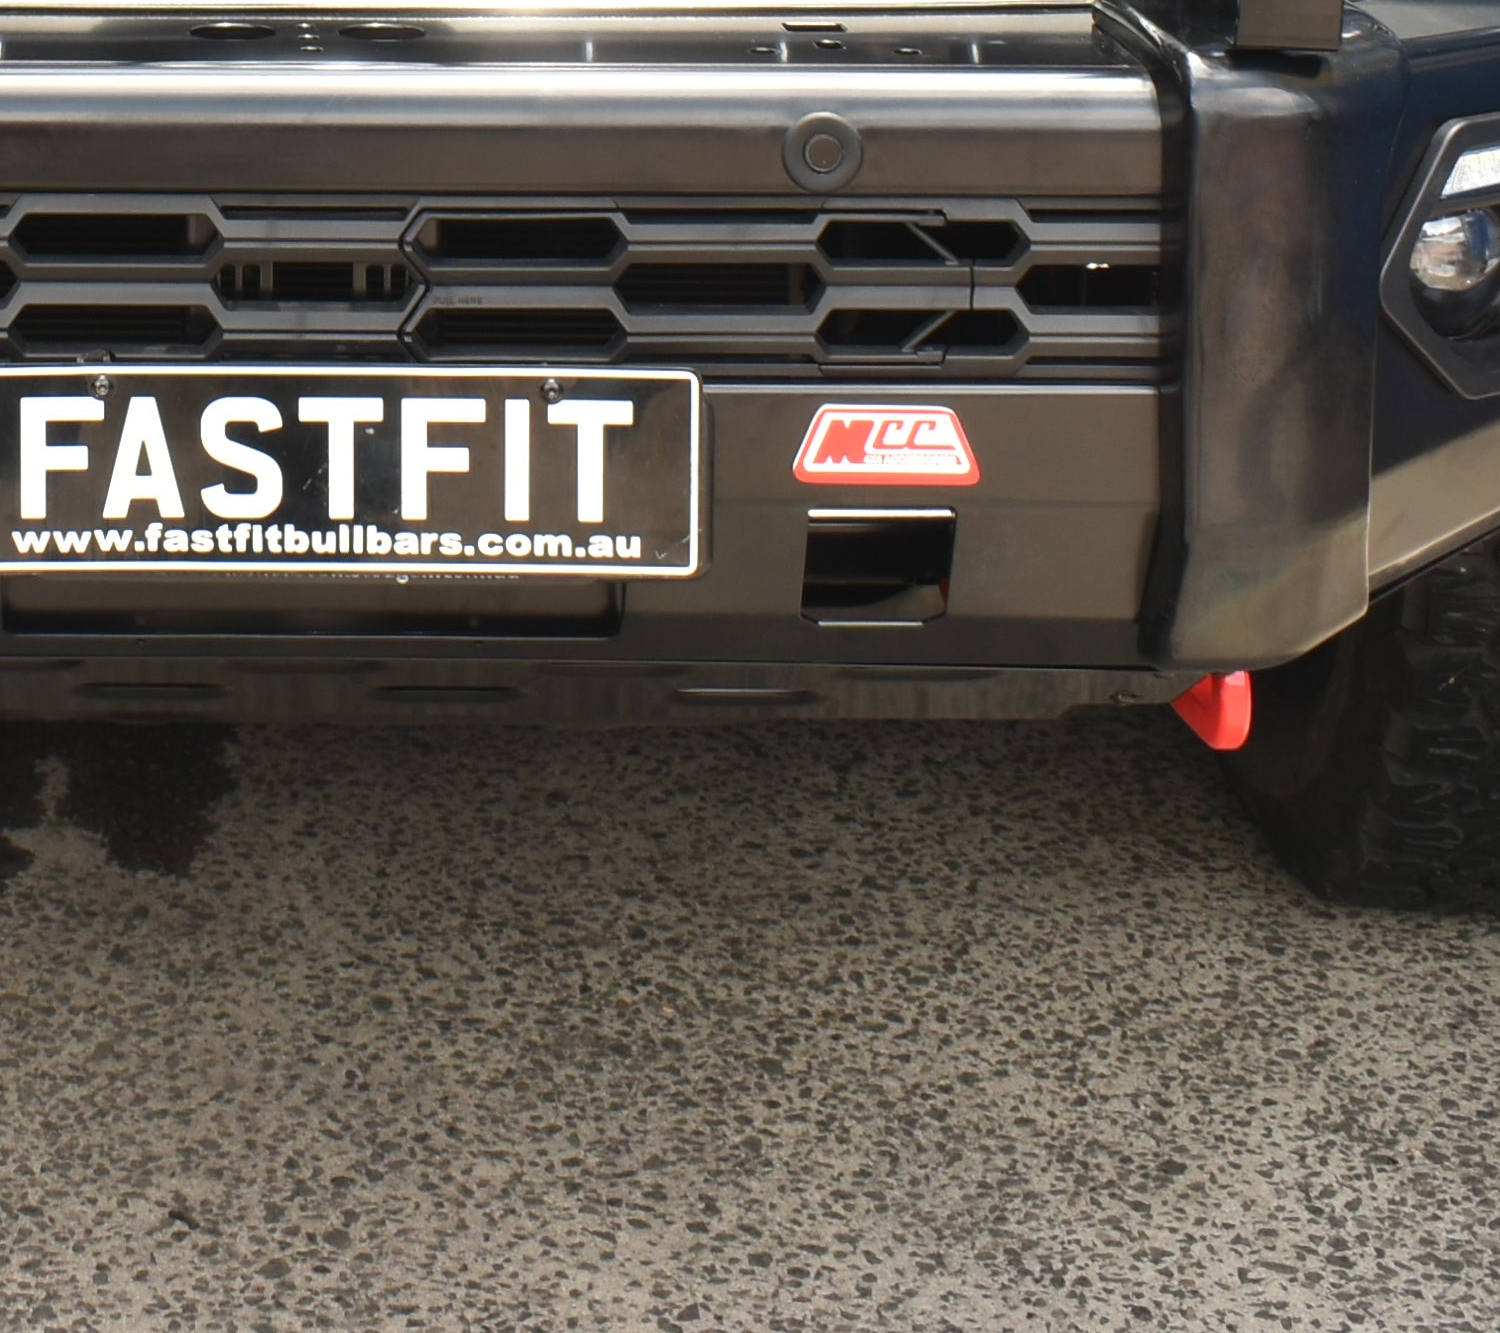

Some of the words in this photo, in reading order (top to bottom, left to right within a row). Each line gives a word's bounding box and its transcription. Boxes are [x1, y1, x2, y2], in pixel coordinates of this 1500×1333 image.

[18, 396, 634, 523] FASTFIT
[811, 418, 957, 465] MCC
[11, 521, 642, 559] www.fastfitbullbars.com.au
